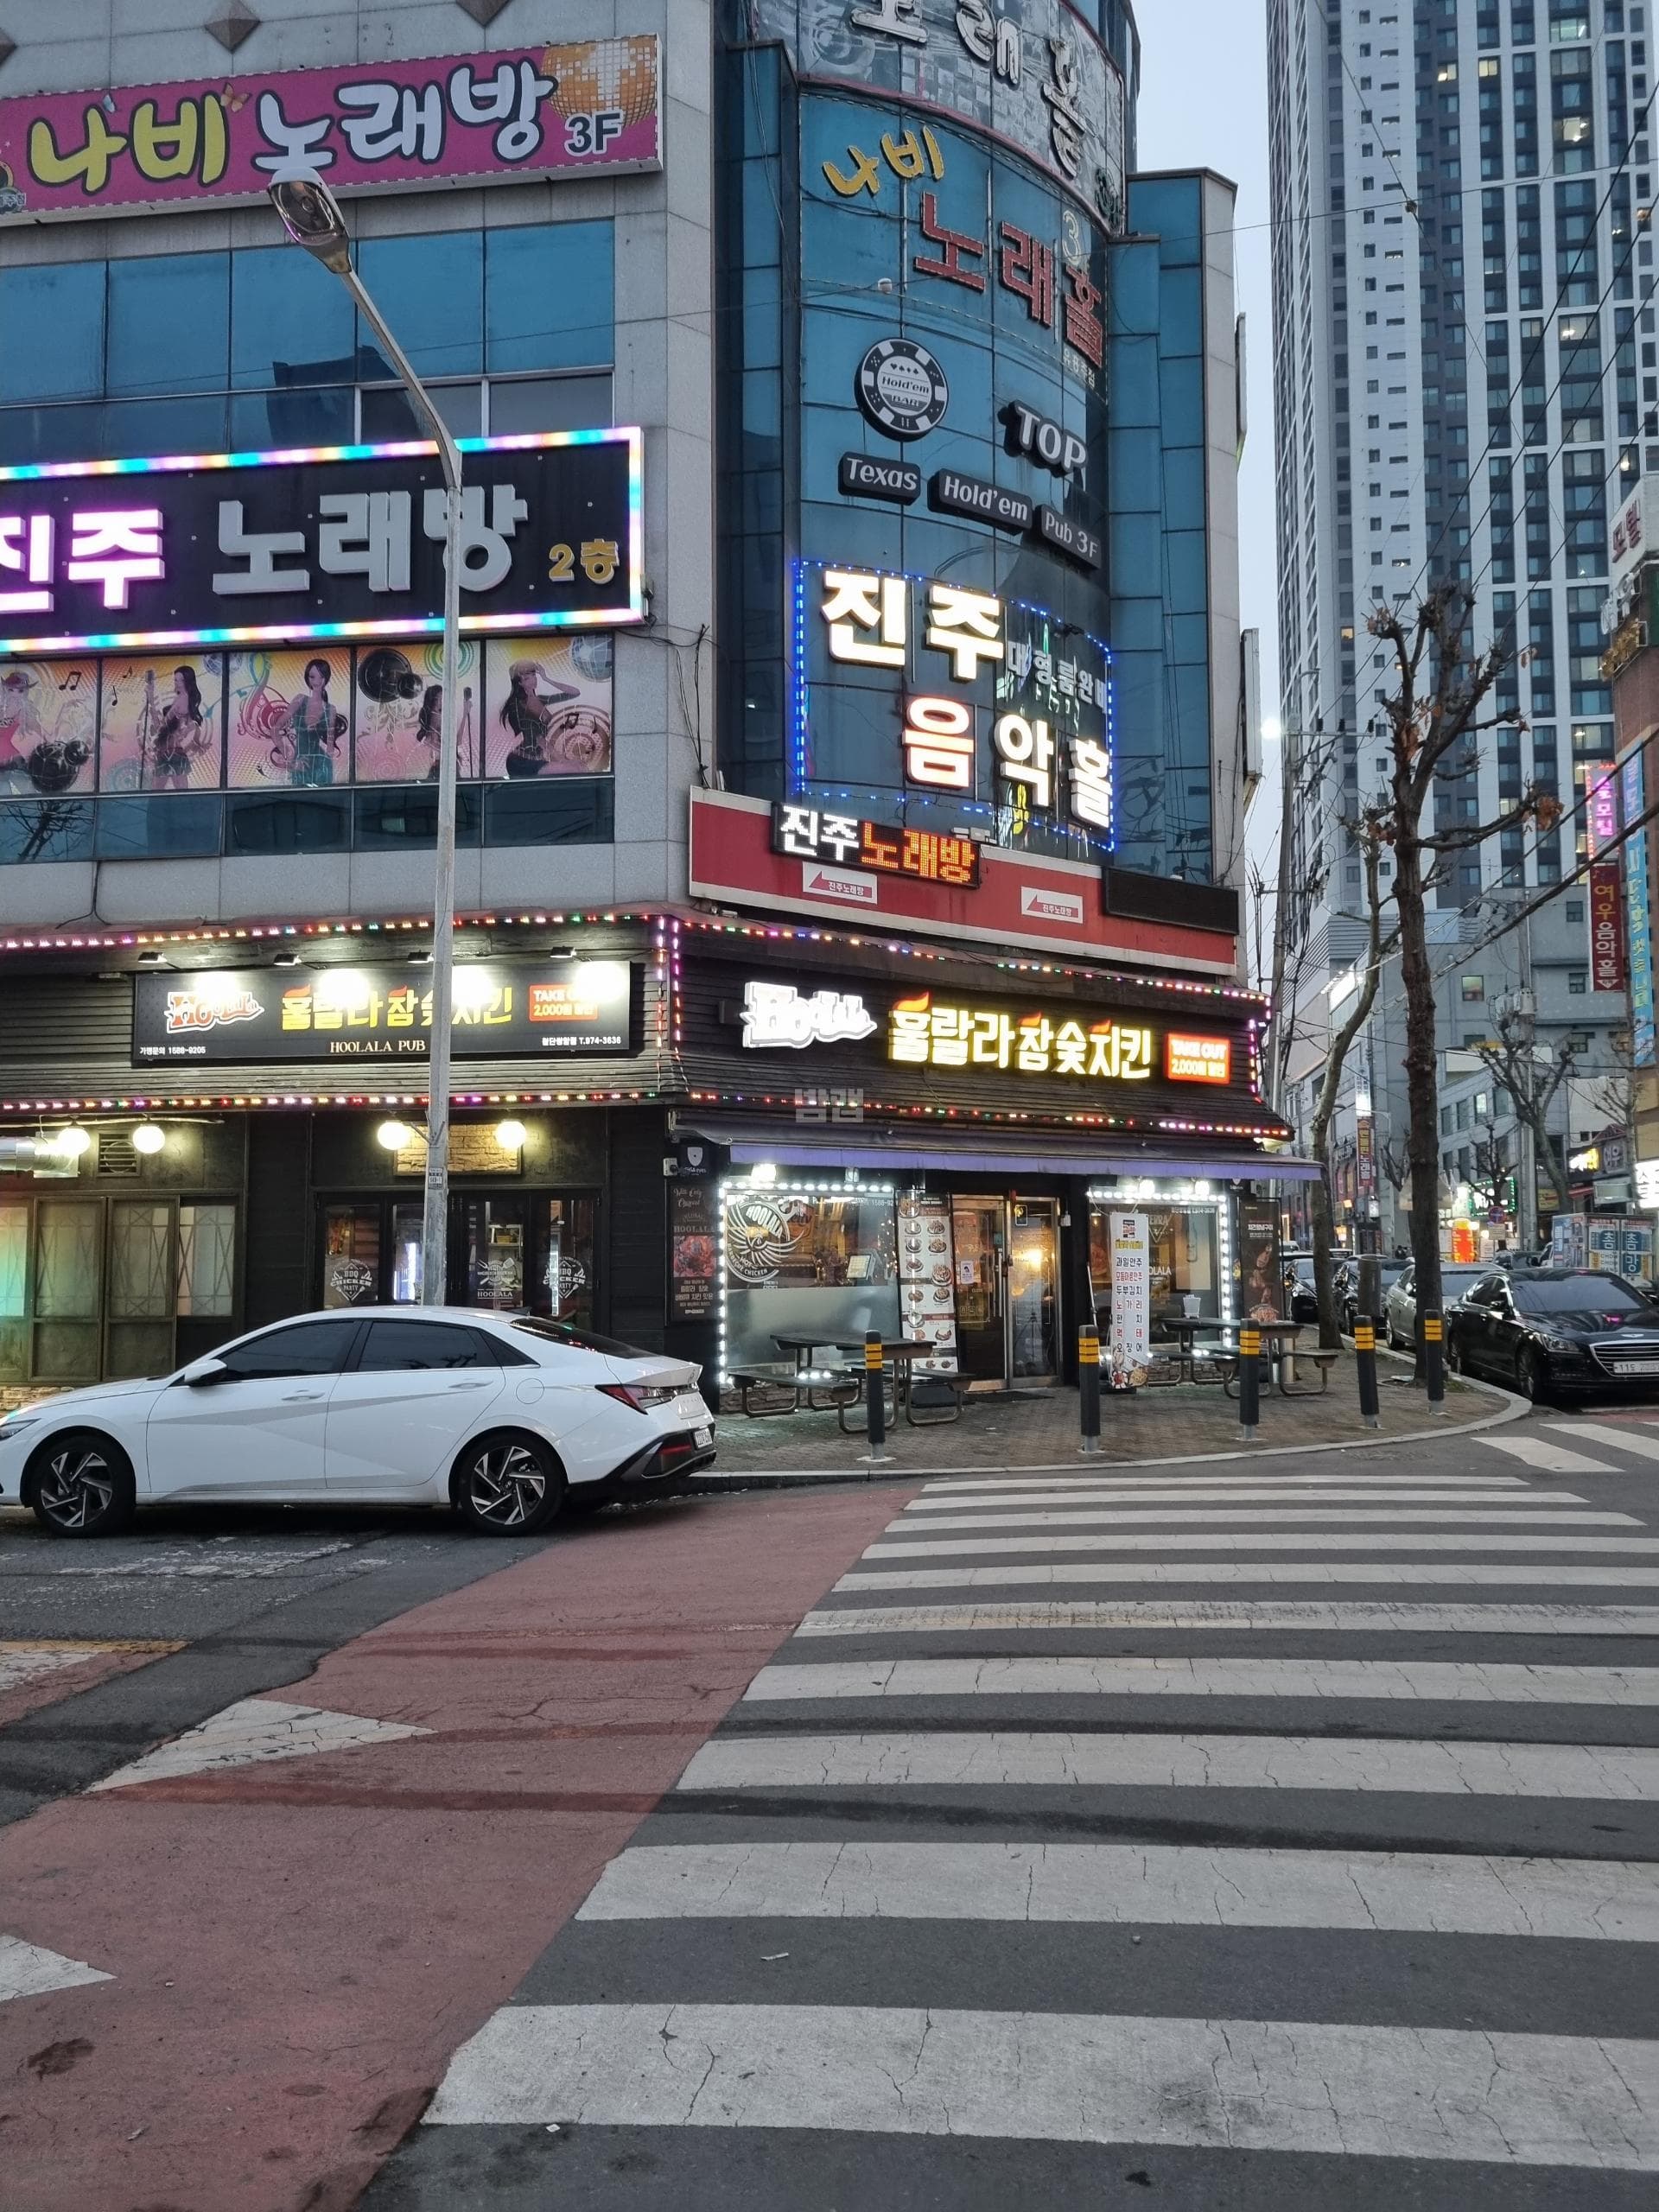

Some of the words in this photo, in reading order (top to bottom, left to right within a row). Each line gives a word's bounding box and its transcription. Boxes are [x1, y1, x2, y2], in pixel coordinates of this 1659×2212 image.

[29, 93, 227, 192] 나비
[253, 59, 557, 173] 노래방
[565, 111, 623, 156] 3F
[823, 126, 944, 195] 나비
[914, 191, 1103, 368] 노래홀
[881, 376, 930, 394] Hold'em
[891, 395, 919, 407] BAR
[1017, 406, 1086, 473] TOP
[846, 458, 918, 490] Texas
[944, 476, 1027, 521] Hold'em
[1045, 512, 1072, 544] Pub
[1077, 533, 1098, 558] 3F
[0, 509, 165, 613] 진주
[212, 484, 528, 595] 노래방
[548, 537, 620, 585] 2층
[821, 569, 1004, 683] 진주
[901, 697, 1112, 830] 음악홀
[781, 804, 860, 861] 진주
[861, 822, 976, 884] 노래방
[829, 881, 864, 896] 진주노래방
[1042, 904, 1071, 917] 진주노래방
[1594, 885, 1618, 978] 여우음악홀
[533, 989, 565, 1002] TAKE
[330, 1041, 392, 1052] HOOLALA
[398, 1040, 426, 1052] PUB
[1171, 1039, 1200, 1057] TAKE
[1201, 1043, 1226, 1059] OUT
[746, 1205, 784, 1239] HOOLALA
[740, 1257, 753, 1268] HOT
[1116, 1256, 1143, 1268] 과일안주
[744, 1268, 768, 1276] CHICKEN
[1116, 1285, 1142, 1296] 두부김치
[1116, 1300, 1142, 1310] 노가리
[1116, 1314, 1142, 1325] 한치
[1116, 1342, 1142, 1353] 오징어
